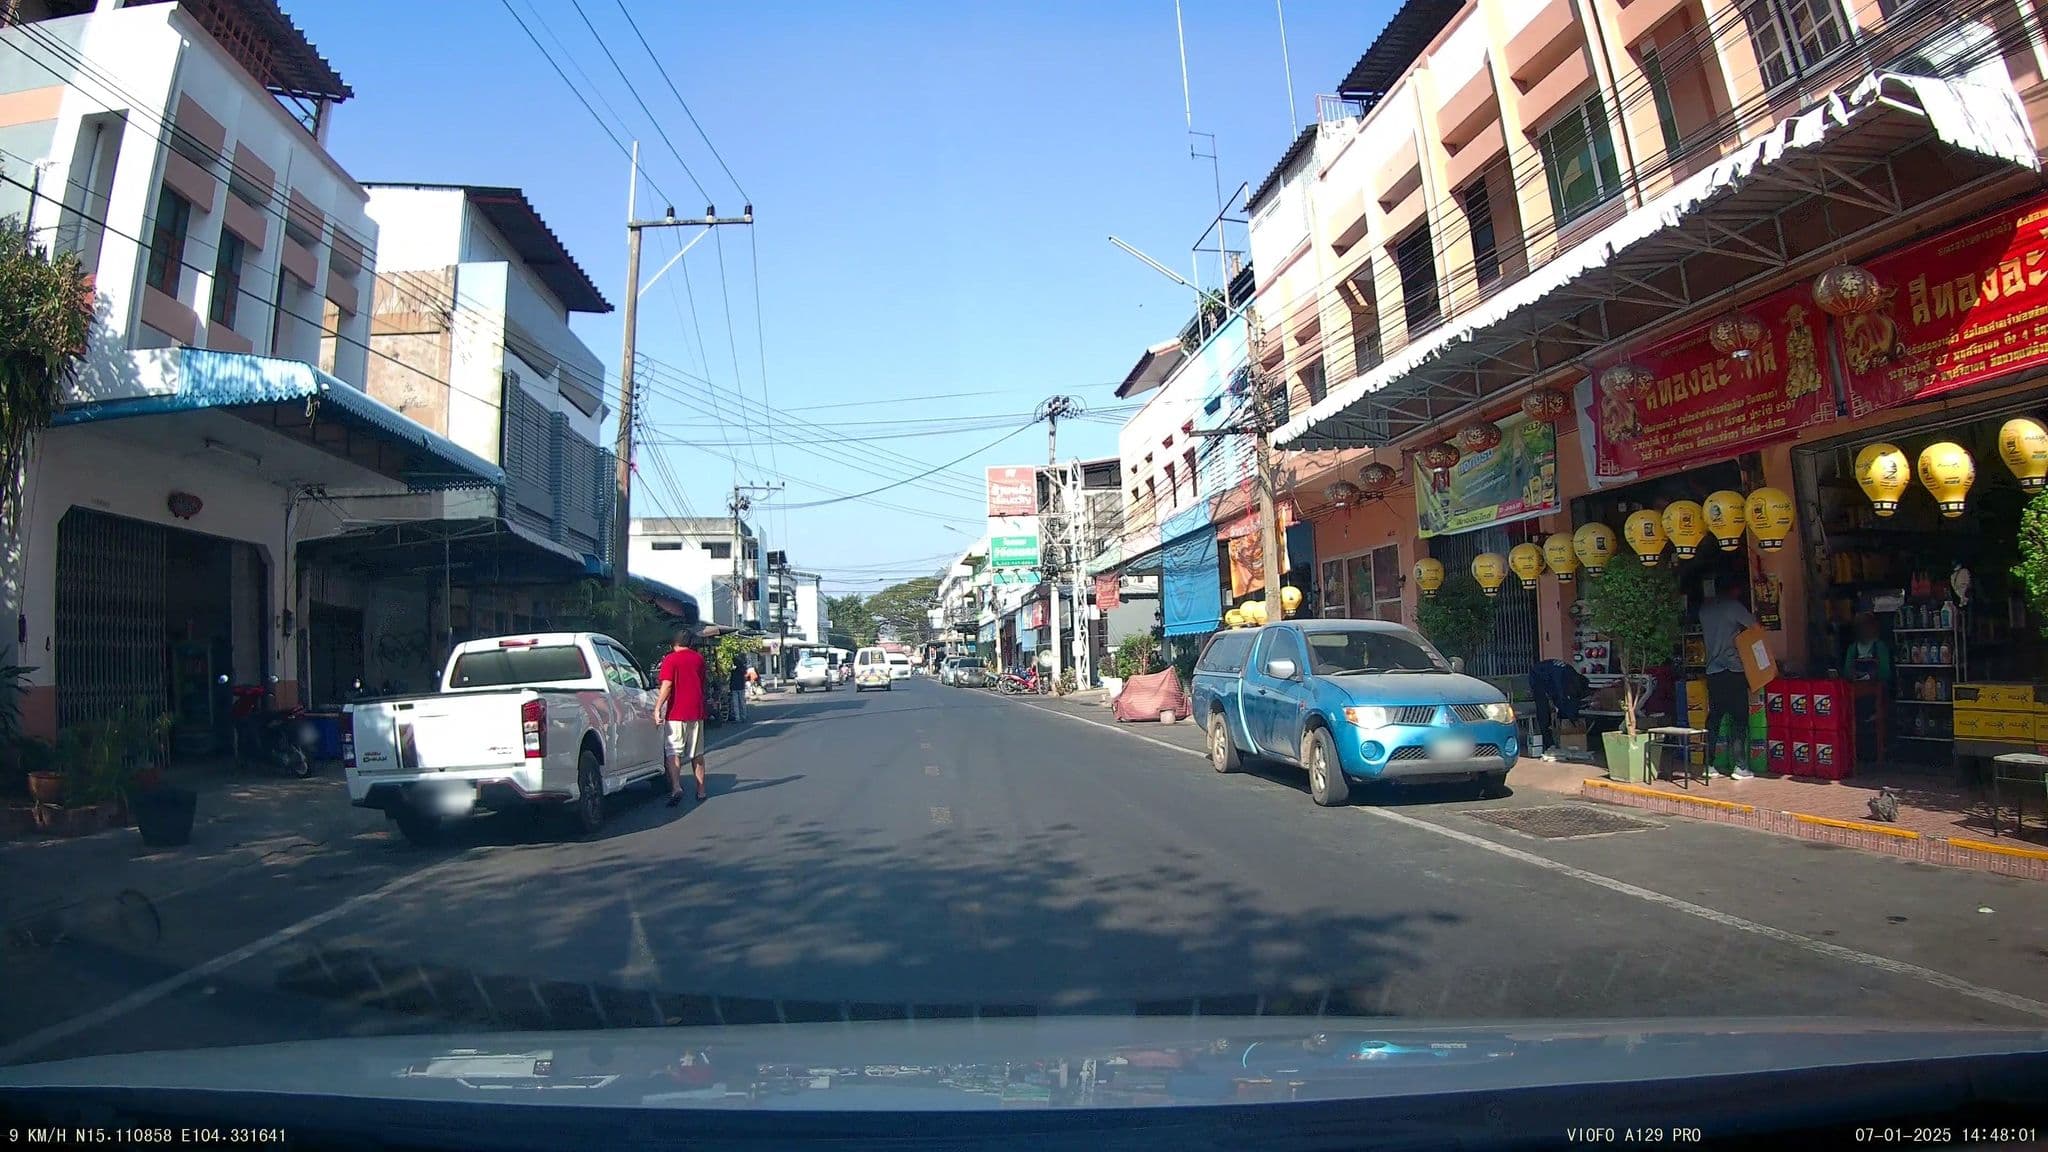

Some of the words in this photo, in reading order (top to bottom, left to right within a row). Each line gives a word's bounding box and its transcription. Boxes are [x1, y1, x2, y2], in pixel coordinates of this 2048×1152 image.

[1935, 353, 1949, 366] 27
[2022, 329, 2029, 340] 4
[1924, 374, 1936, 387] 27
[1775, 400, 1796, 413] 2567
